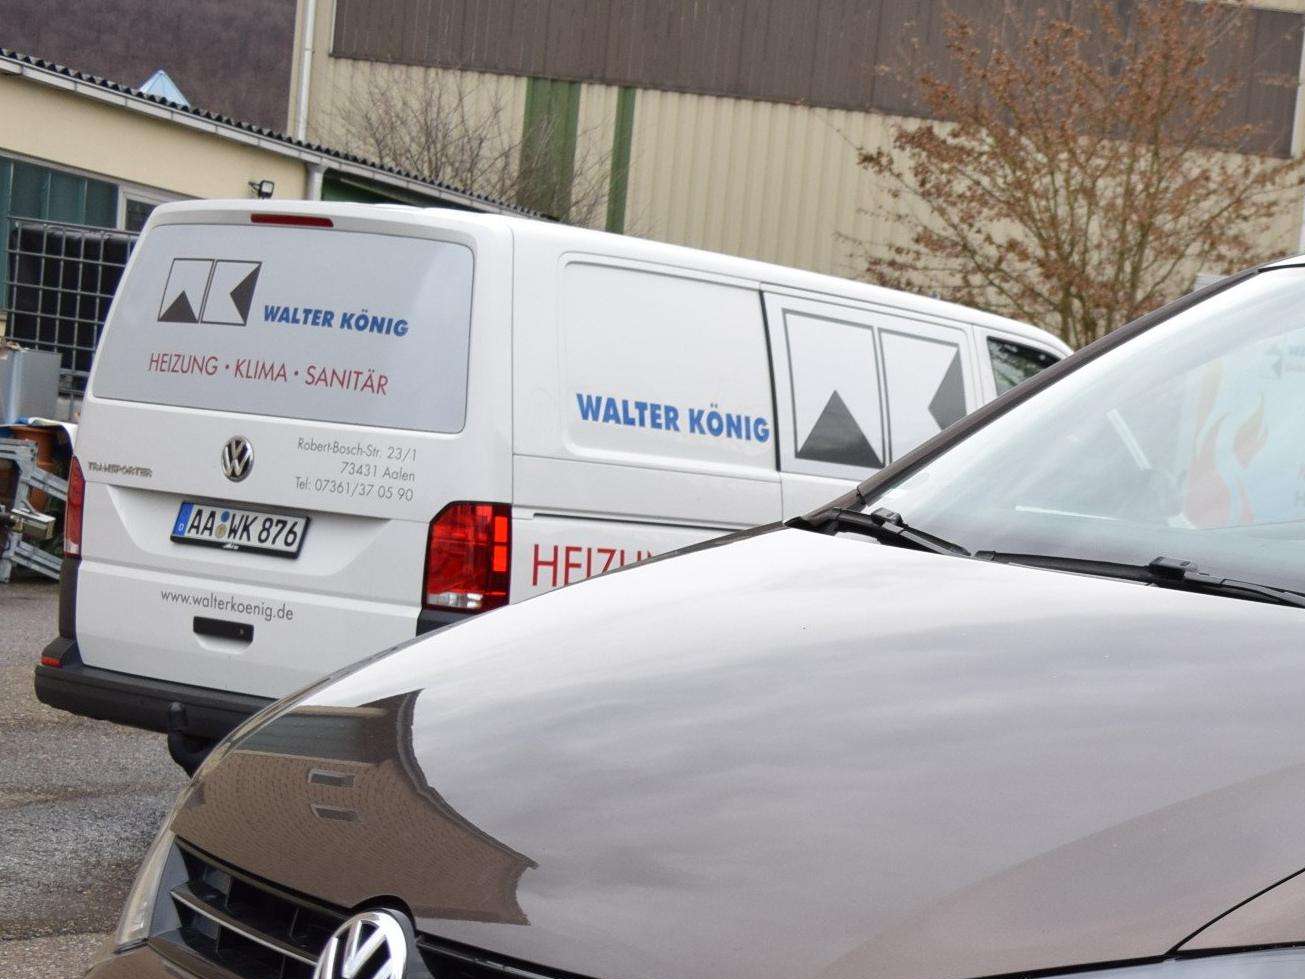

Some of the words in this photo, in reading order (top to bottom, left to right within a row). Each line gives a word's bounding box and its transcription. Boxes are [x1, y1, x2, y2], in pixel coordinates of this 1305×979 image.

[264, 304, 334, 329] WALTER
[340, 308, 409, 338] KÖNIG
[149, 352, 219, 377] HEIZUNG
[234, 358, 288, 383] KLIMA
[304, 364, 389, 397] SANITÄR
[575, 392, 681, 433] WALTER
[688, 402, 771, 444] KÖNIG
[88, 461, 154, 479] TRANSPORTER
[387, 446, 417, 462] 23/1
[339, 460, 378, 478] 73431
[382, 466, 416, 482] Aalen
[314, 478, 374, 498] 07361/37
[378, 485, 393, 500] 05
[398, 487, 414, 502] 90
[187, 508, 217, 537] AA
[227, 513, 258, 542] WK
[257, 517, 299, 547] 876
[532, 543, 653, 588] HEIZ
[161, 589, 294, 621] www.walterkoenig.de
